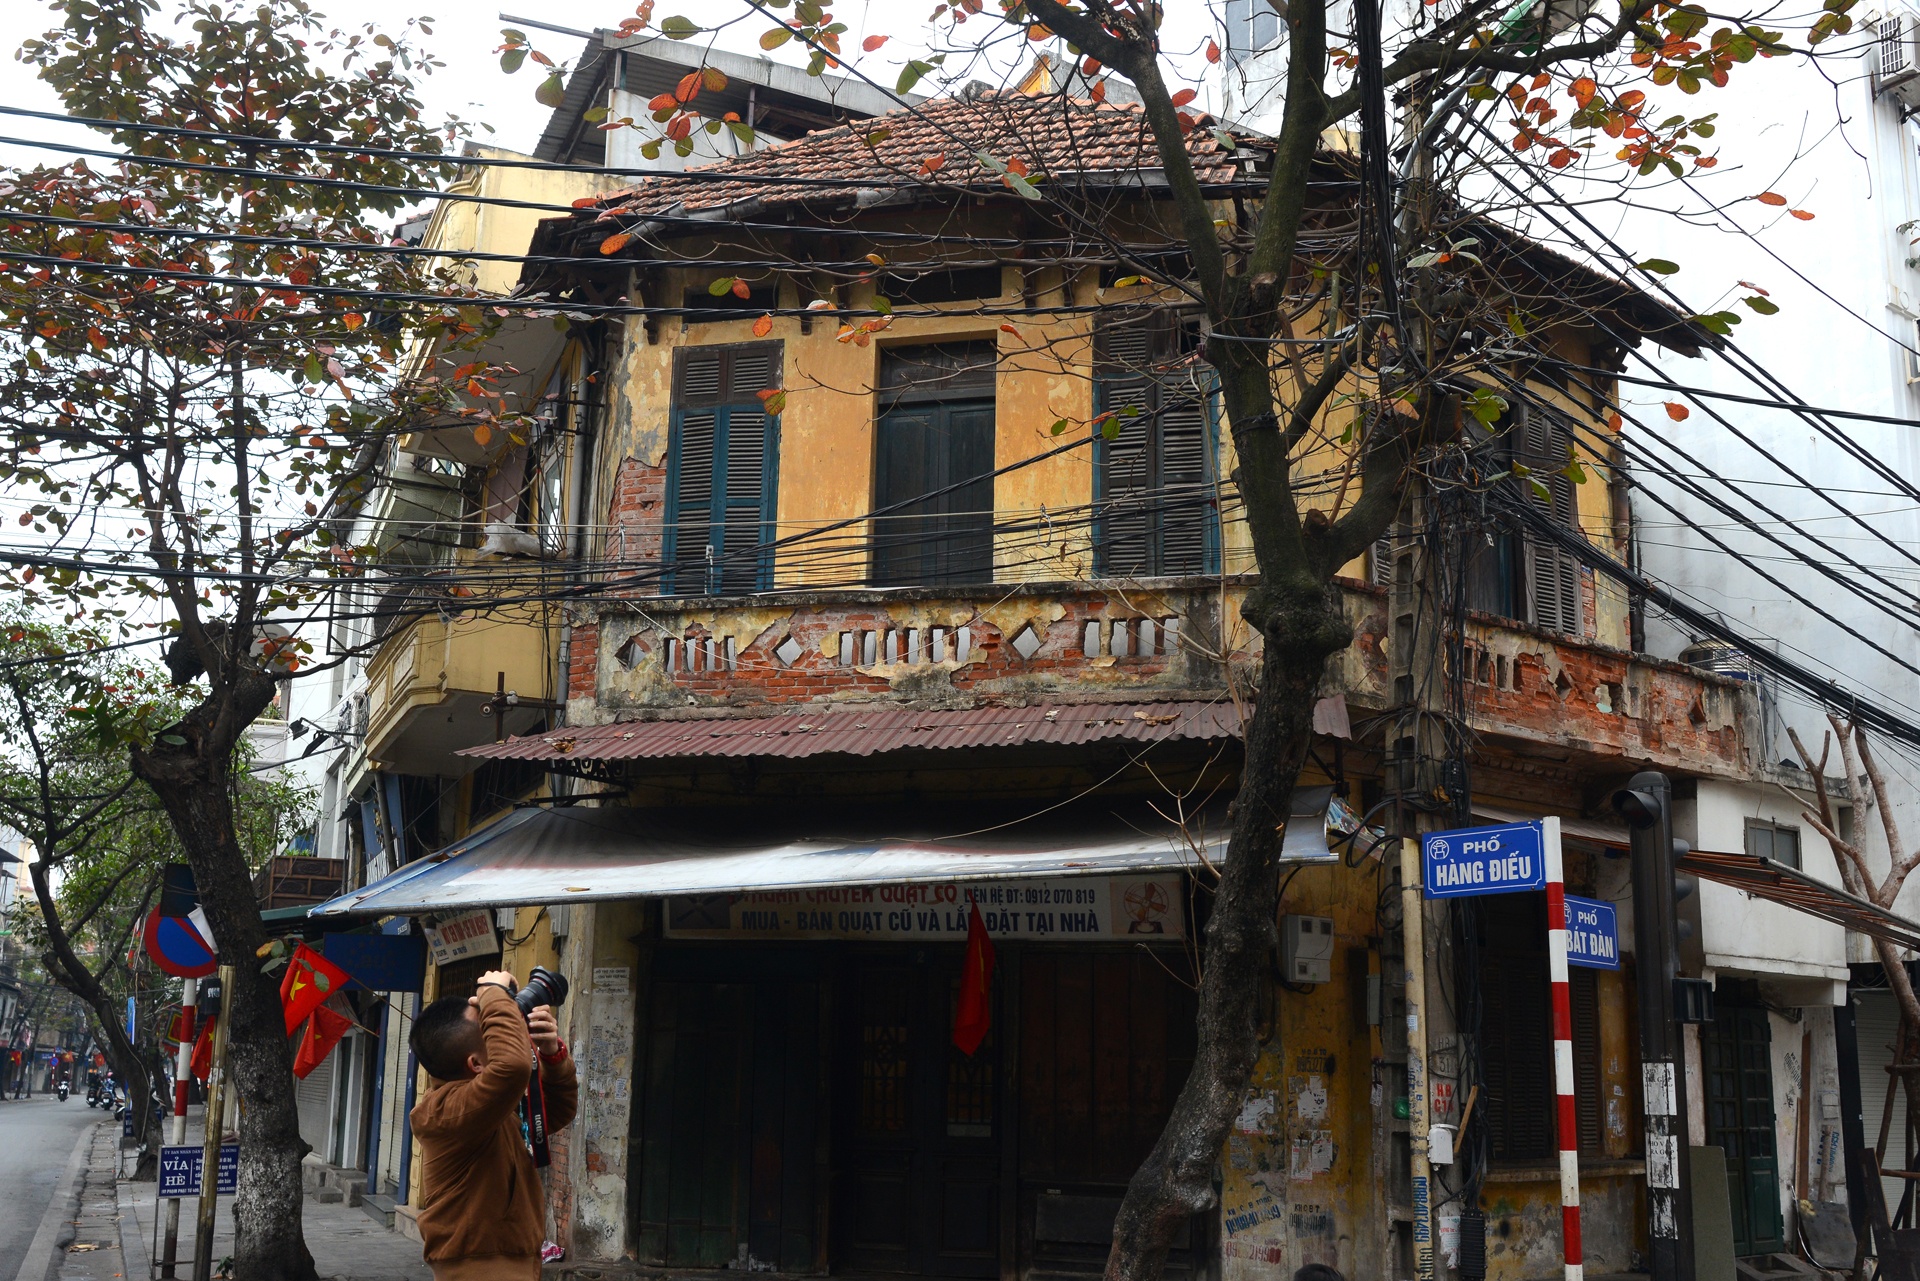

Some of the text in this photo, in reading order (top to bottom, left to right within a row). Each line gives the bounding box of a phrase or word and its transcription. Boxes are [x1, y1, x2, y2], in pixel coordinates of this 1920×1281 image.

[1463, 834, 1500, 855] PHỐ
[1436, 851, 1532, 886] HÀNG ĐIẾU
[990, 886, 1003, 906] HỆ
[1025, 888, 1050, 904] 0912
[1053, 888, 1073, 904] 070
[1075, 888, 1096, 904] 819
[741, 911, 780, 930] MUA
[799, 908, 832, 930] BÁN
[838, 911, 883, 934] QUẠT
[888, 908, 912, 931] CŨ
[917, 908, 940, 931] VÀ
[946, 905, 972, 931] LẮ
[986, 910, 1020, 935] ĐẶT
[1026, 911, 1054, 935] TẠI
[1061, 908, 1099, 931] NHÀ
[1578, 909, 1598, 926] PHỐ
[1566, 926, 1614, 958] BÁT ĐÀN
[1436, 1083, 1452, 1097] HB
[534, 1113, 544, 1144] Canon
[163, 1155, 189, 1171] VỈA
[165, 1173, 186, 1186] HÈ
